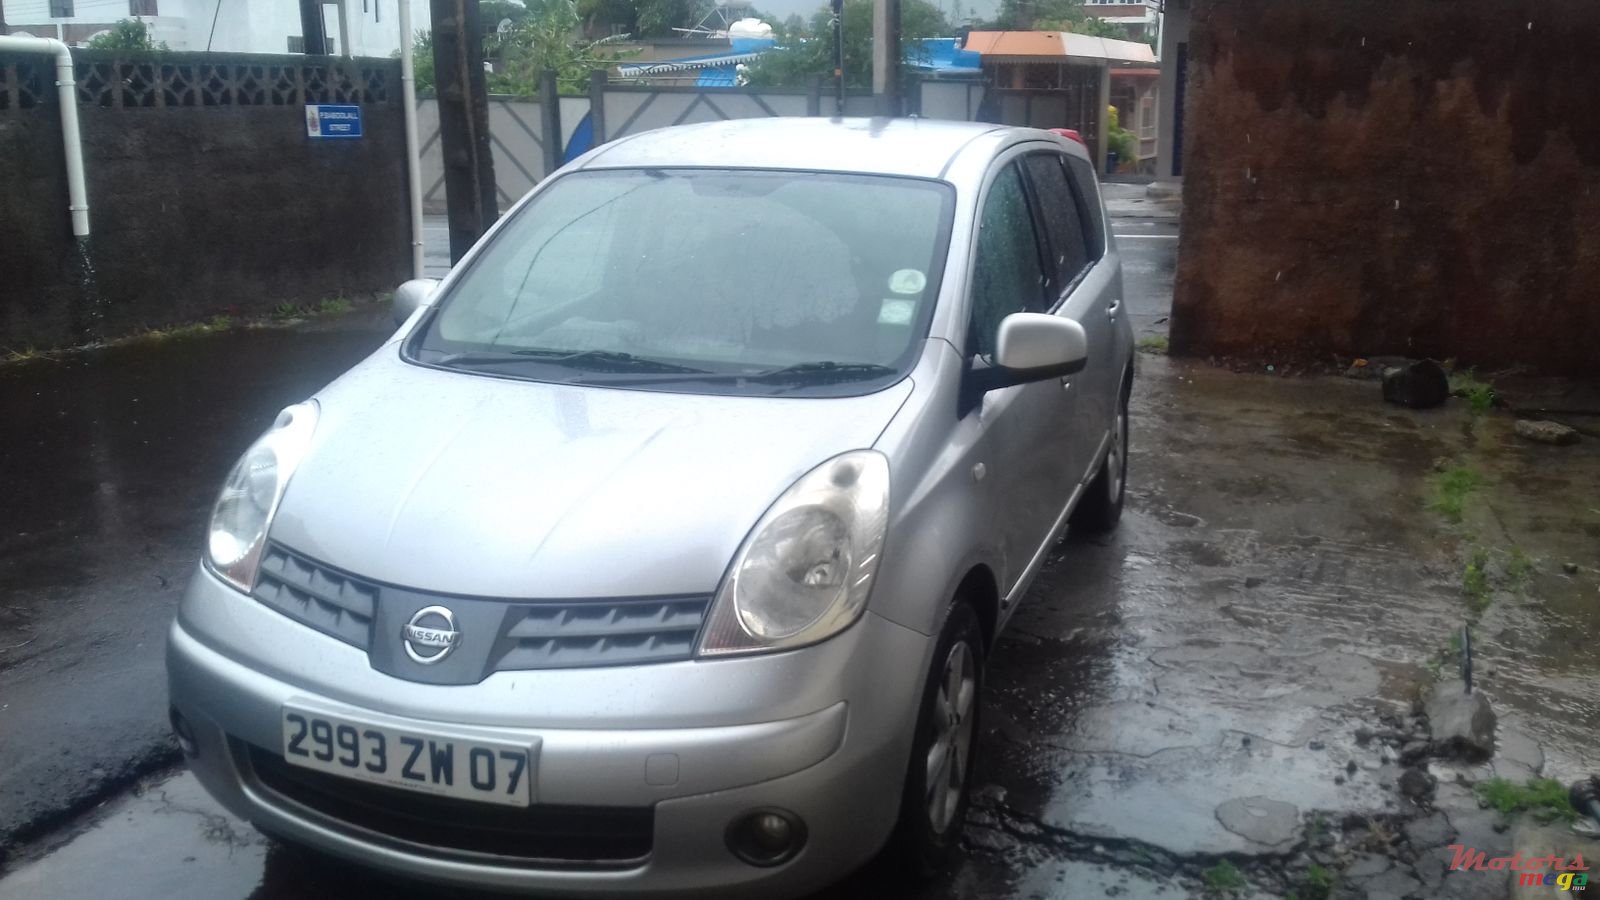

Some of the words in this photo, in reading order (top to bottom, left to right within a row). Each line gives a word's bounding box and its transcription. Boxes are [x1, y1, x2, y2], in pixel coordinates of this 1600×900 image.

[329, 123, 351, 131] STREET
[406, 628, 454, 643] NISSAN
[287, 713, 387, 774] 2993
[400, 736, 454, 786] ZW
[470, 747, 526, 795] 07
